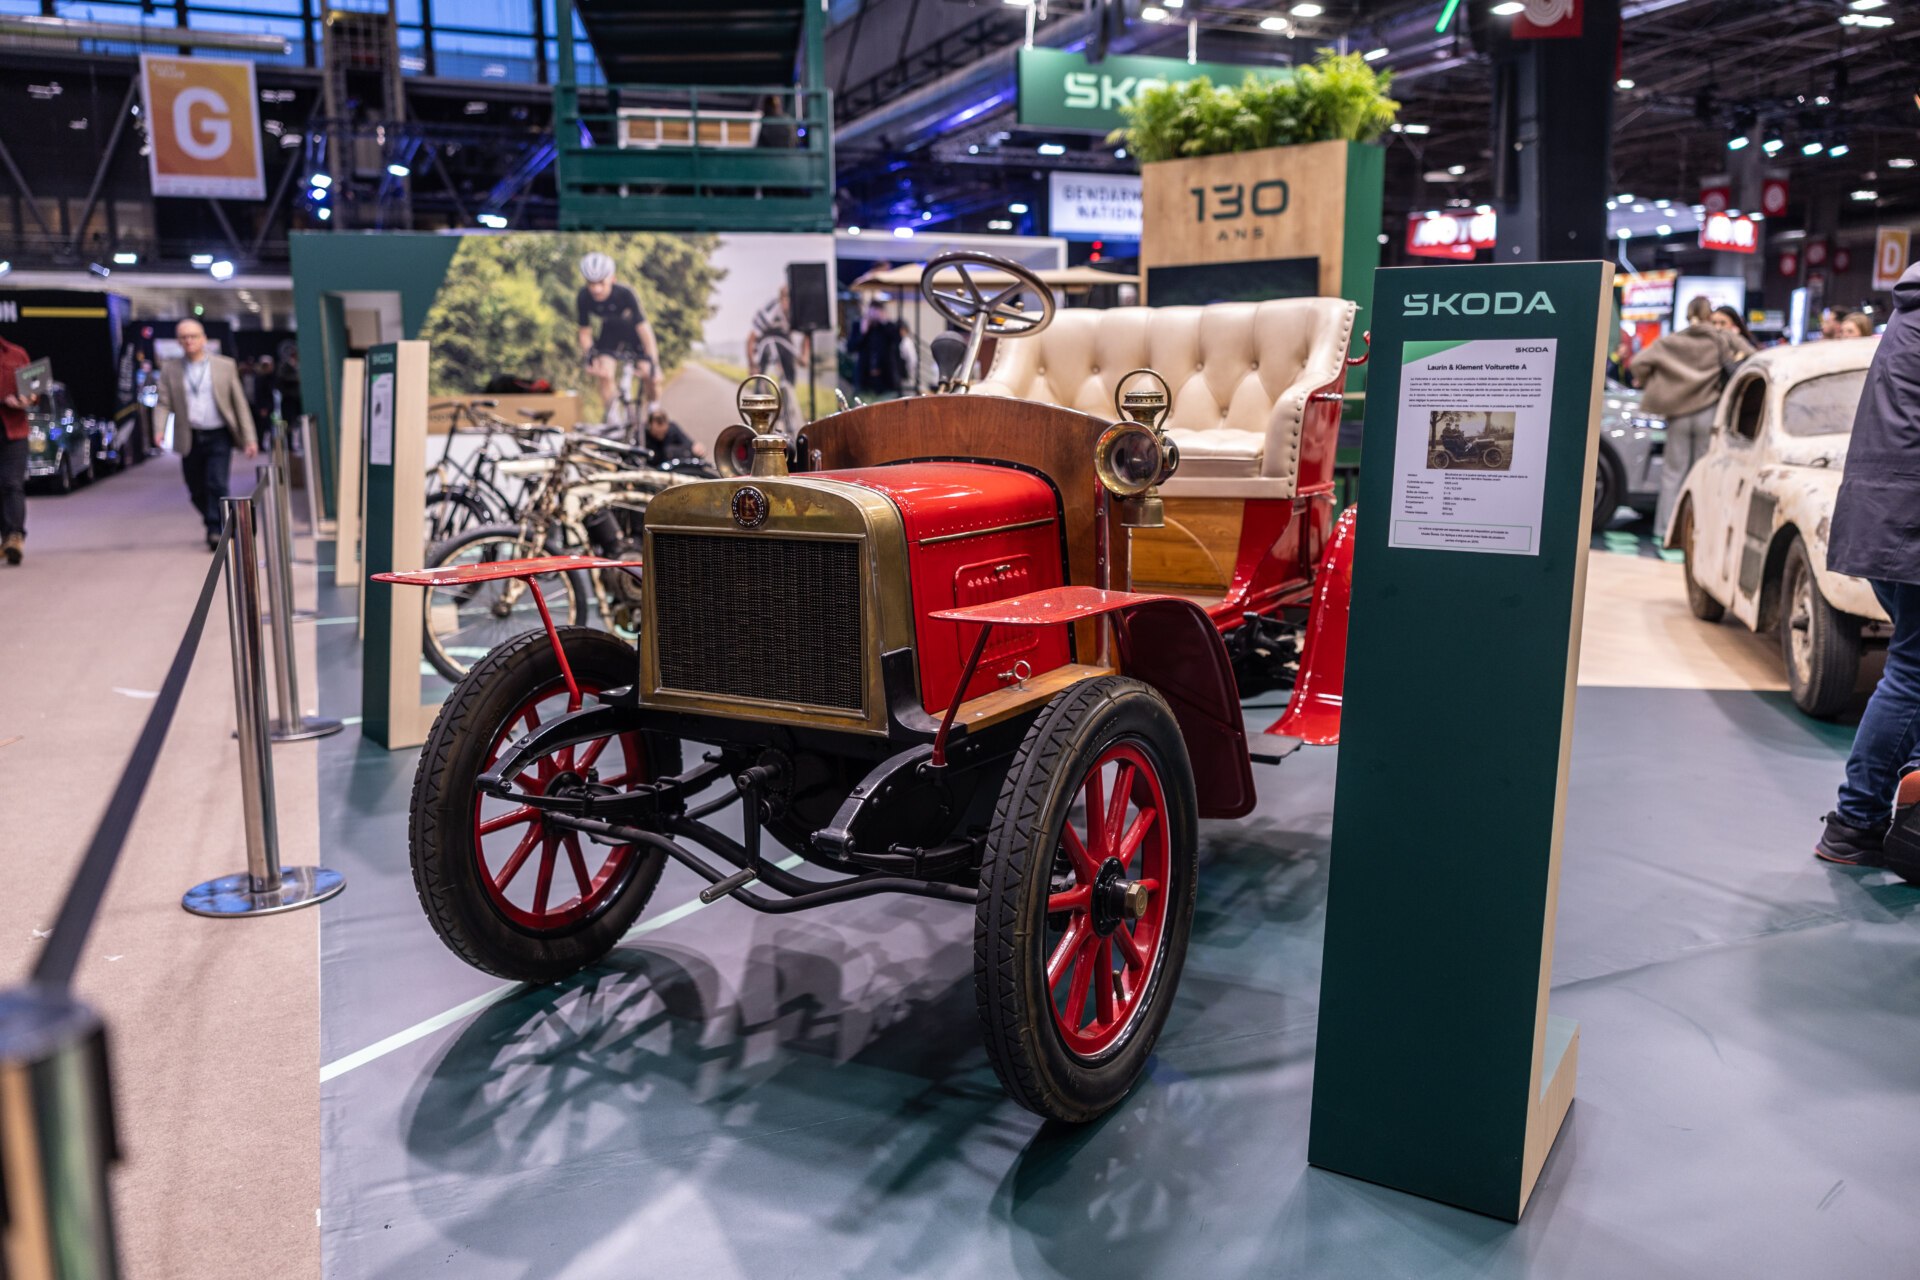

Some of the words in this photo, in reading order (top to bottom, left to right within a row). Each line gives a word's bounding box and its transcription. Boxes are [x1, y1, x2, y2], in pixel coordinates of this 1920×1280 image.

[172, 86, 233, 161] G
[1077, 206, 1143, 219] NATION
[1190, 178, 1290, 223] 130
[1217, 228, 1264, 242] ANS
[1882, 241, 1902, 274] D
[1402, 291, 1557, 316] SKODA
[1515, 346, 1549, 354] SKODA
